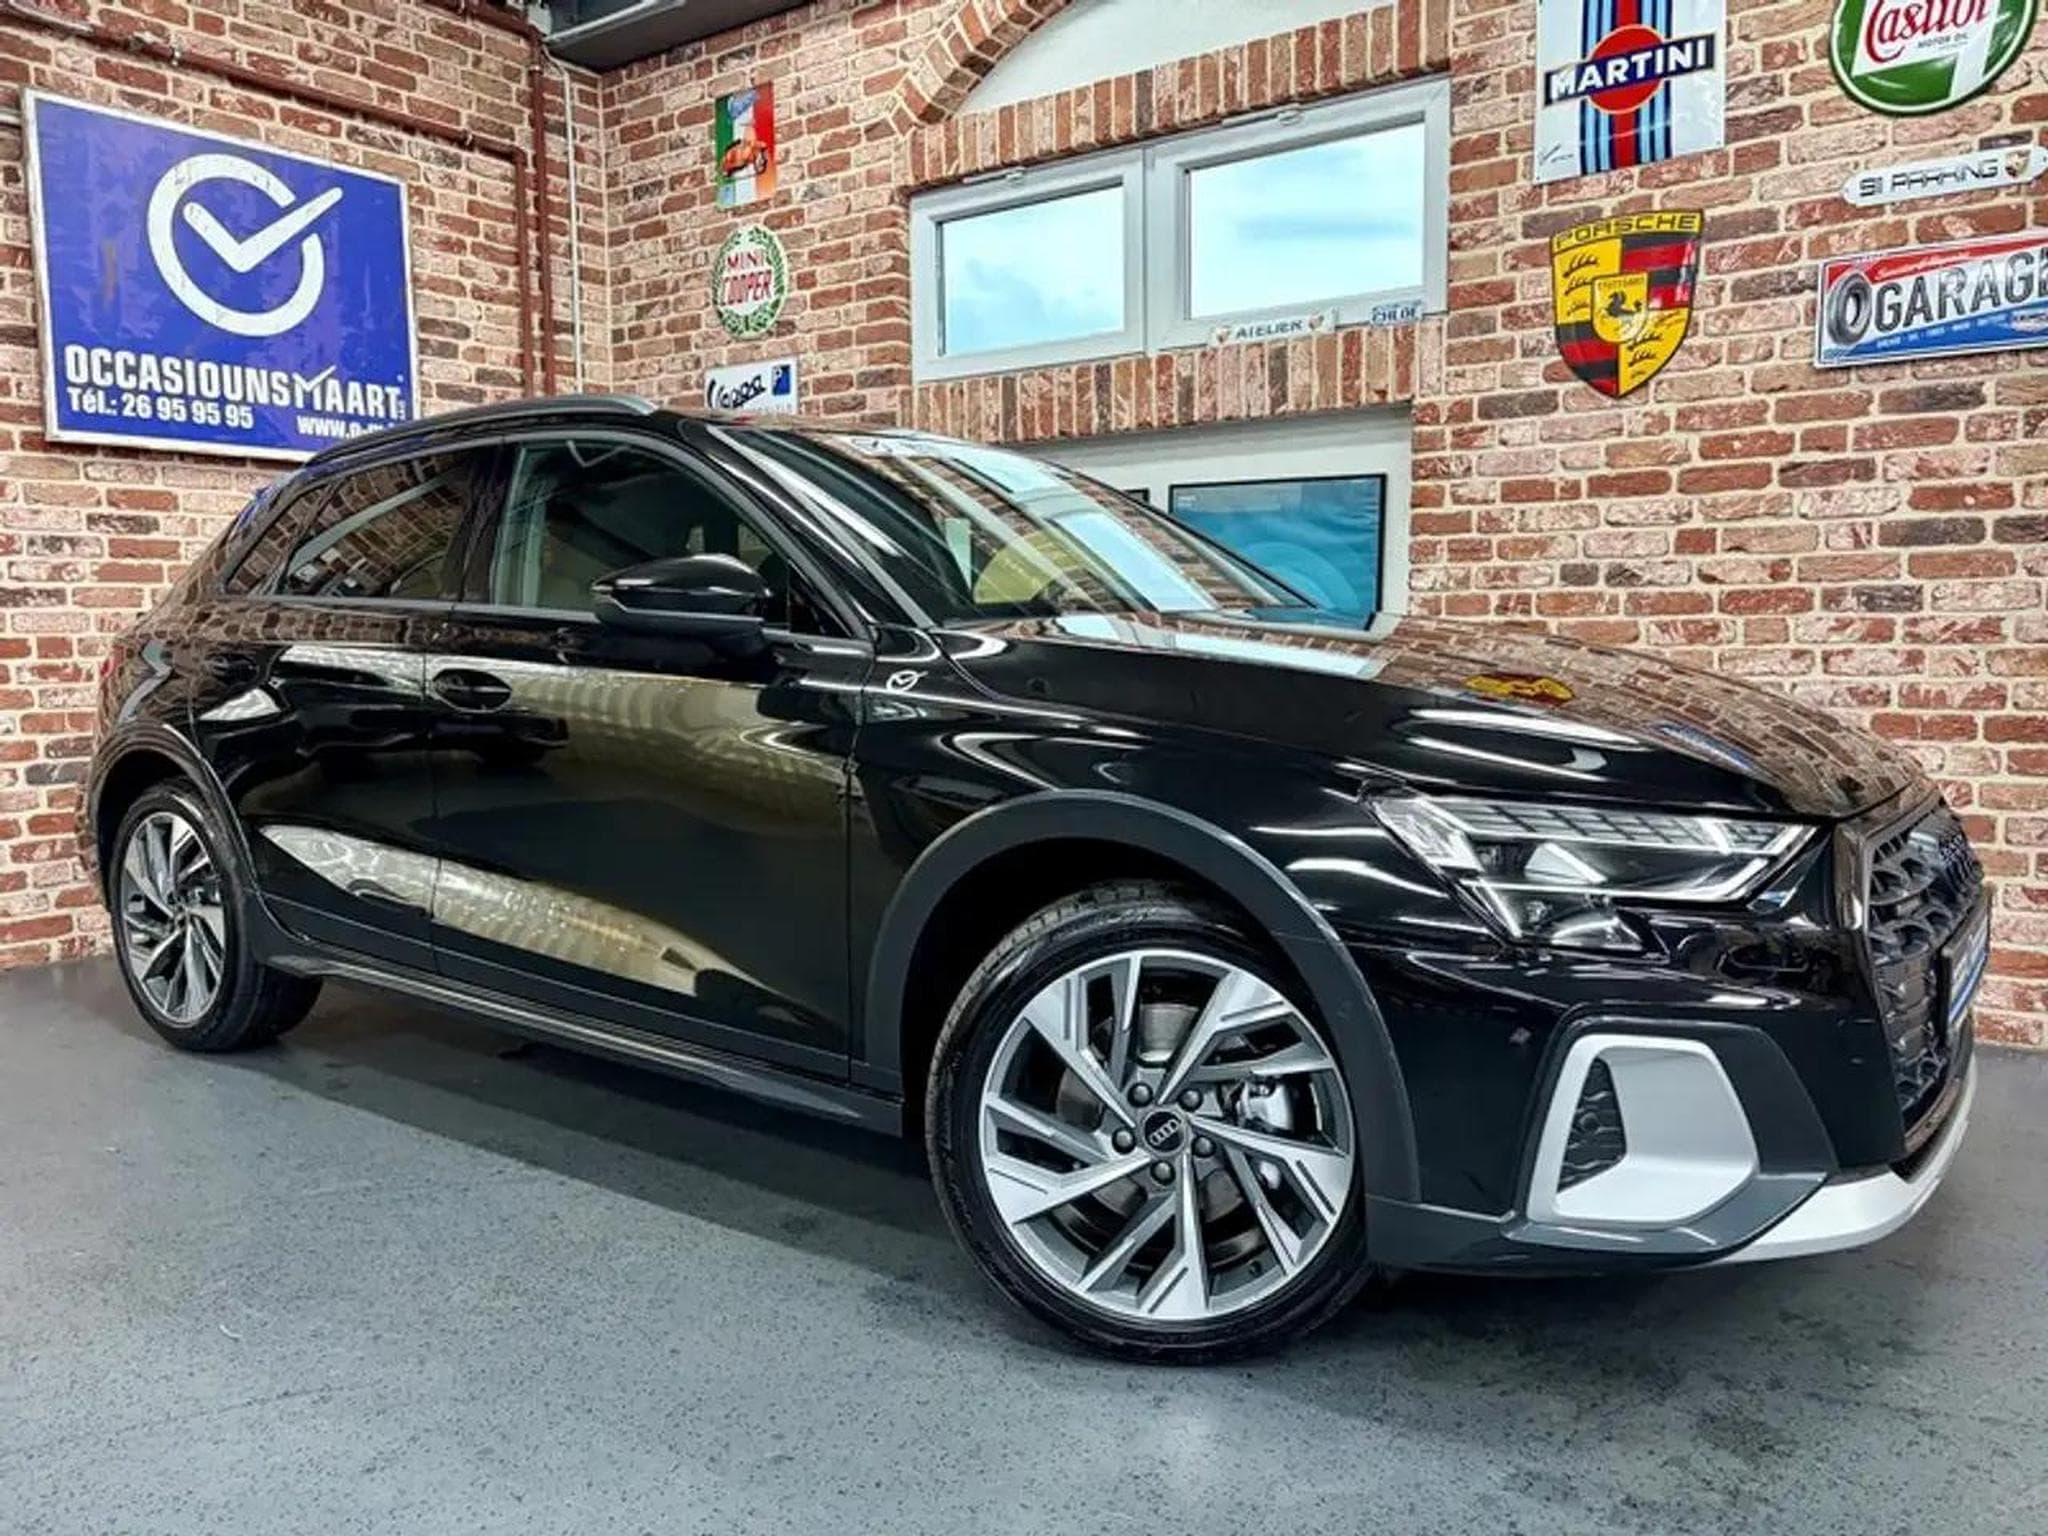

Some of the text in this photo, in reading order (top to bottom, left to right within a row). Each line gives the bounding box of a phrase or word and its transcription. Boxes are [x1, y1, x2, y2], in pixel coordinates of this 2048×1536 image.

[1551, 39, 1706, 99] MARTINI
[1556, 214, 1697, 249] PORSCHE
[720, 269, 772, 305] COOPER
[122, 392, 153, 420] 26
[156, 396, 187, 423] 95
[192, 400, 222, 427] 95
[224, 404, 254, 430] 95
